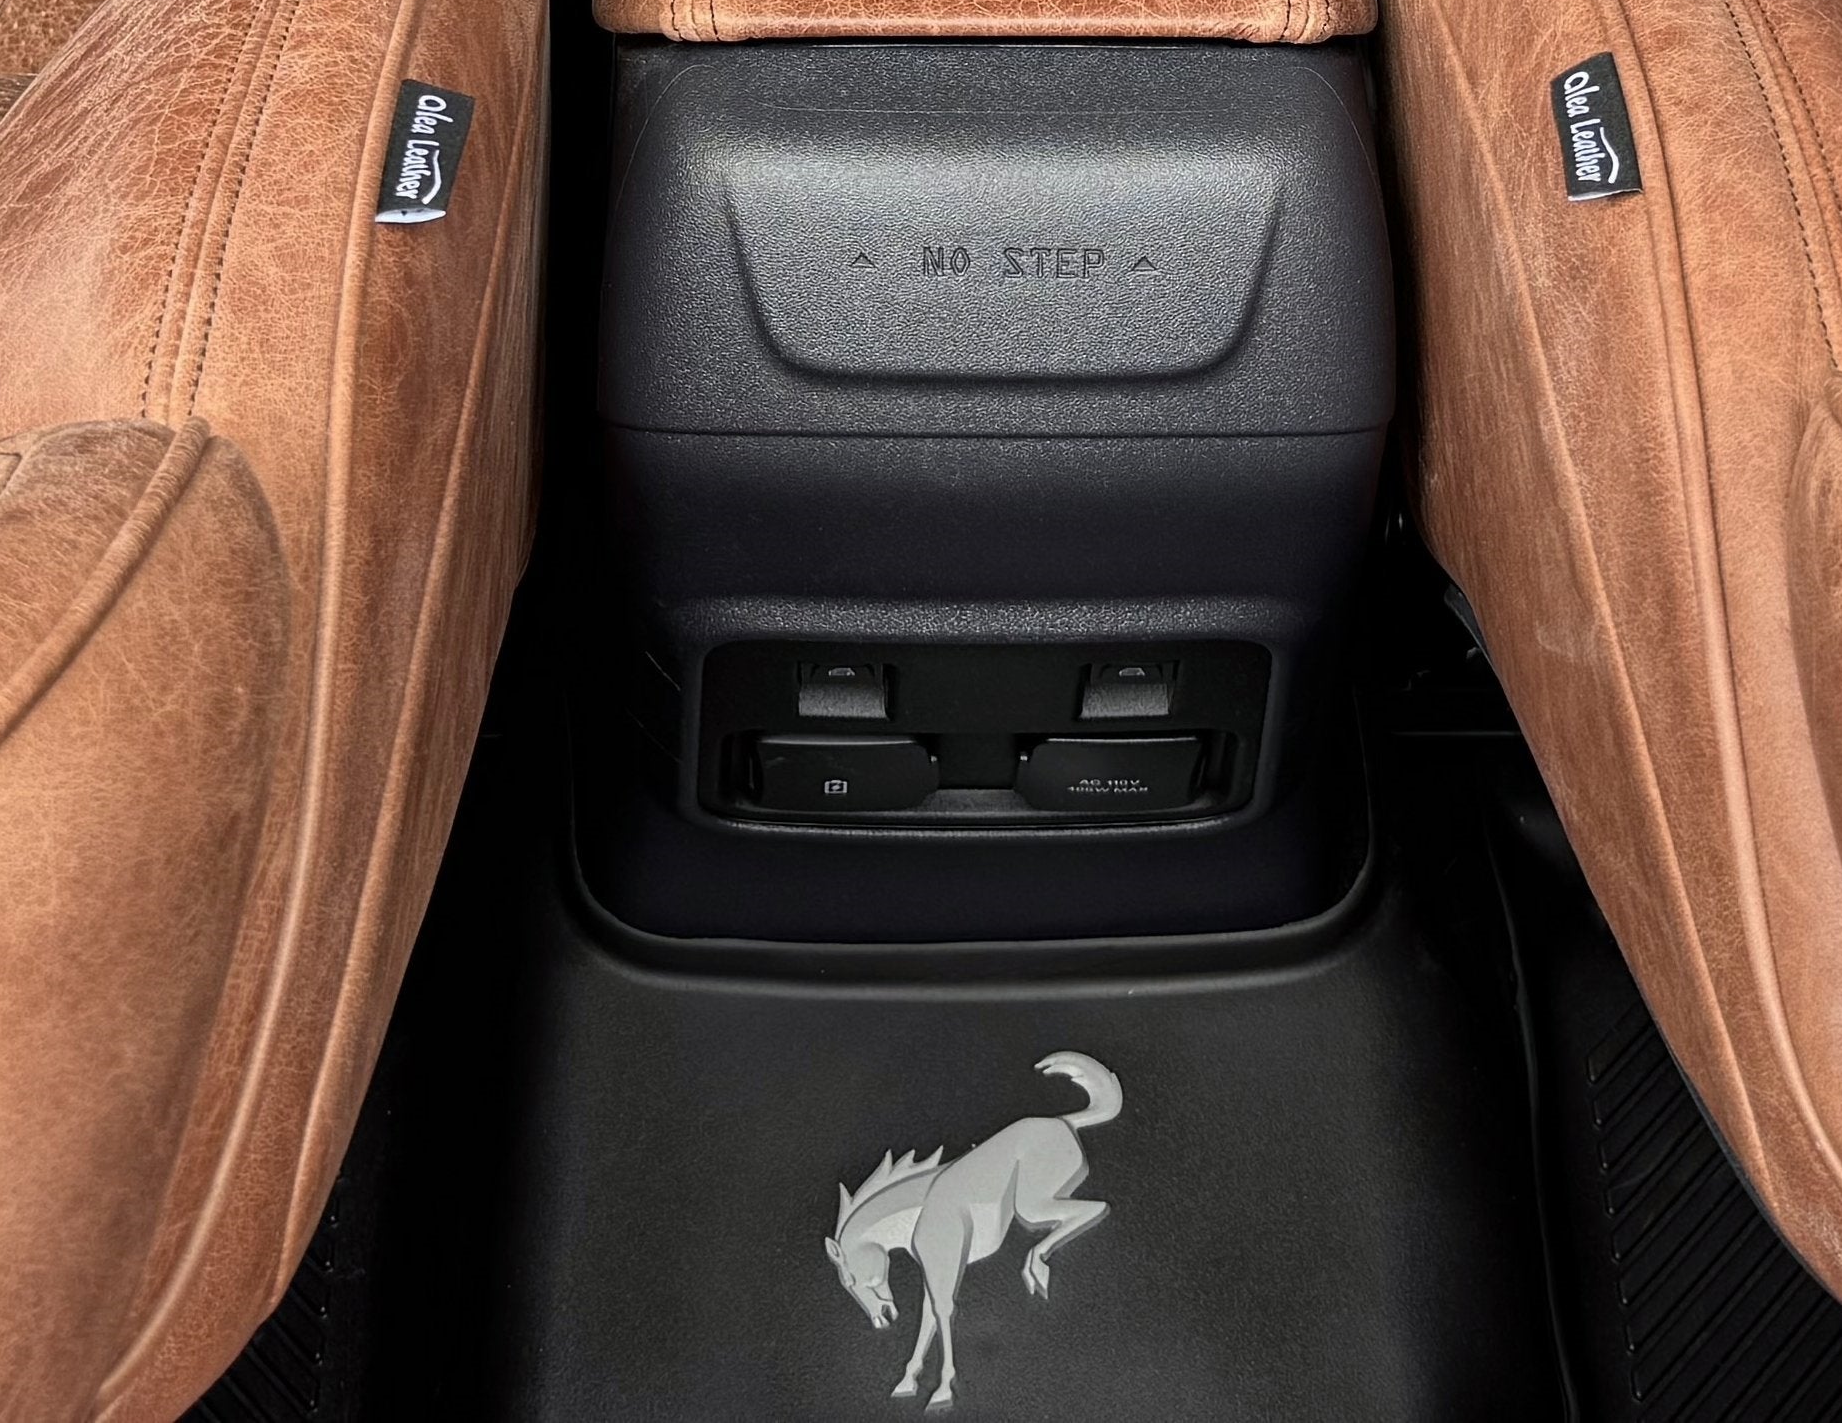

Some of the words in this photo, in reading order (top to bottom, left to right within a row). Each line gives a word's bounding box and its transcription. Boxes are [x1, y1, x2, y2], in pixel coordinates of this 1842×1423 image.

[395, 139, 440, 199] Leather
[1570, 118, 1606, 182] Leather
[922, 246, 971, 277] NO
[1003, 246, 1105, 278] STEP
